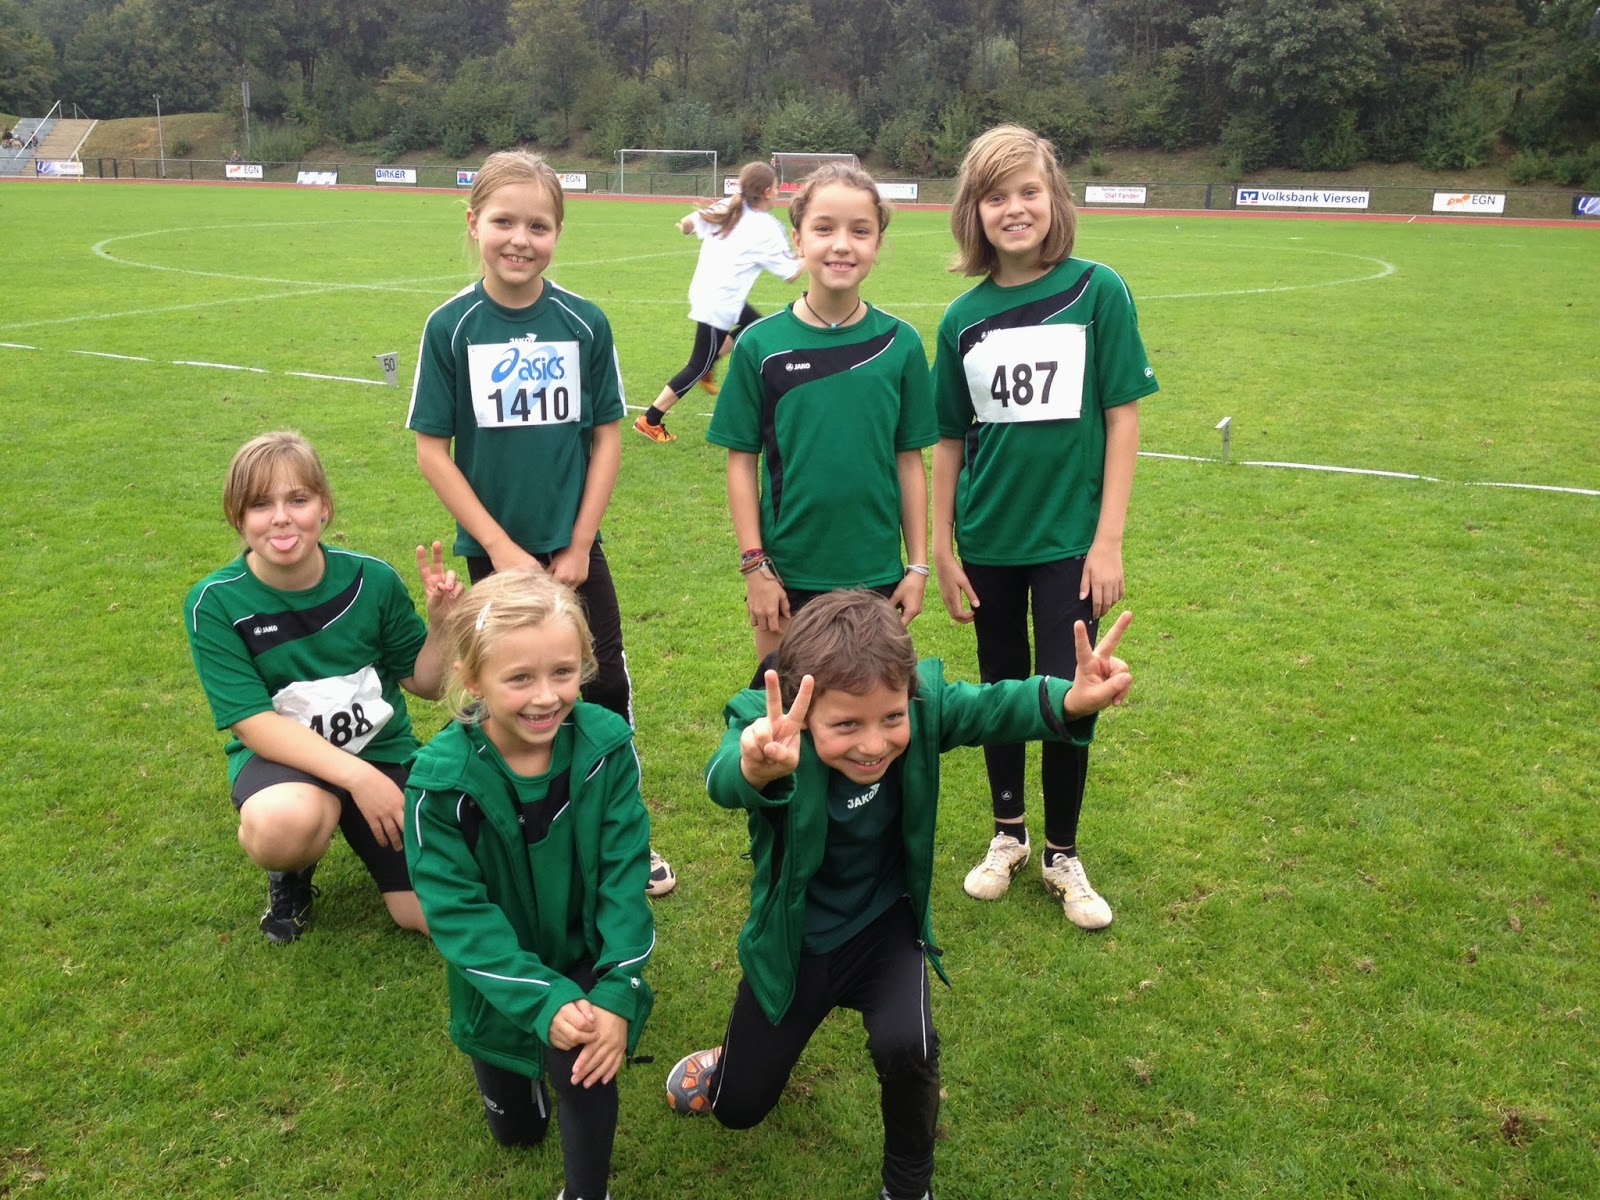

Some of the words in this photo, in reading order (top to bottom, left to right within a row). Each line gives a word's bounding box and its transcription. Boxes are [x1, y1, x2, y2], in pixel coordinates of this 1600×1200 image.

[244, 166, 259, 174] EGN
[377, 170, 406, 179] BIRKER
[1261, 191, 1319, 203] Volksbank
[1323, 193, 1366, 204] Viersen
[1472, 195, 1496, 205] EGN
[384, 358, 396, 372] 50
[518, 356, 565, 381] asics
[794, 362, 811, 371] JAKO
[990, 360, 1058, 408] 487
[488, 386, 569, 423] 1410
[262, 625, 278, 634] JAKO
[847, 790, 875, 809] JAKO
